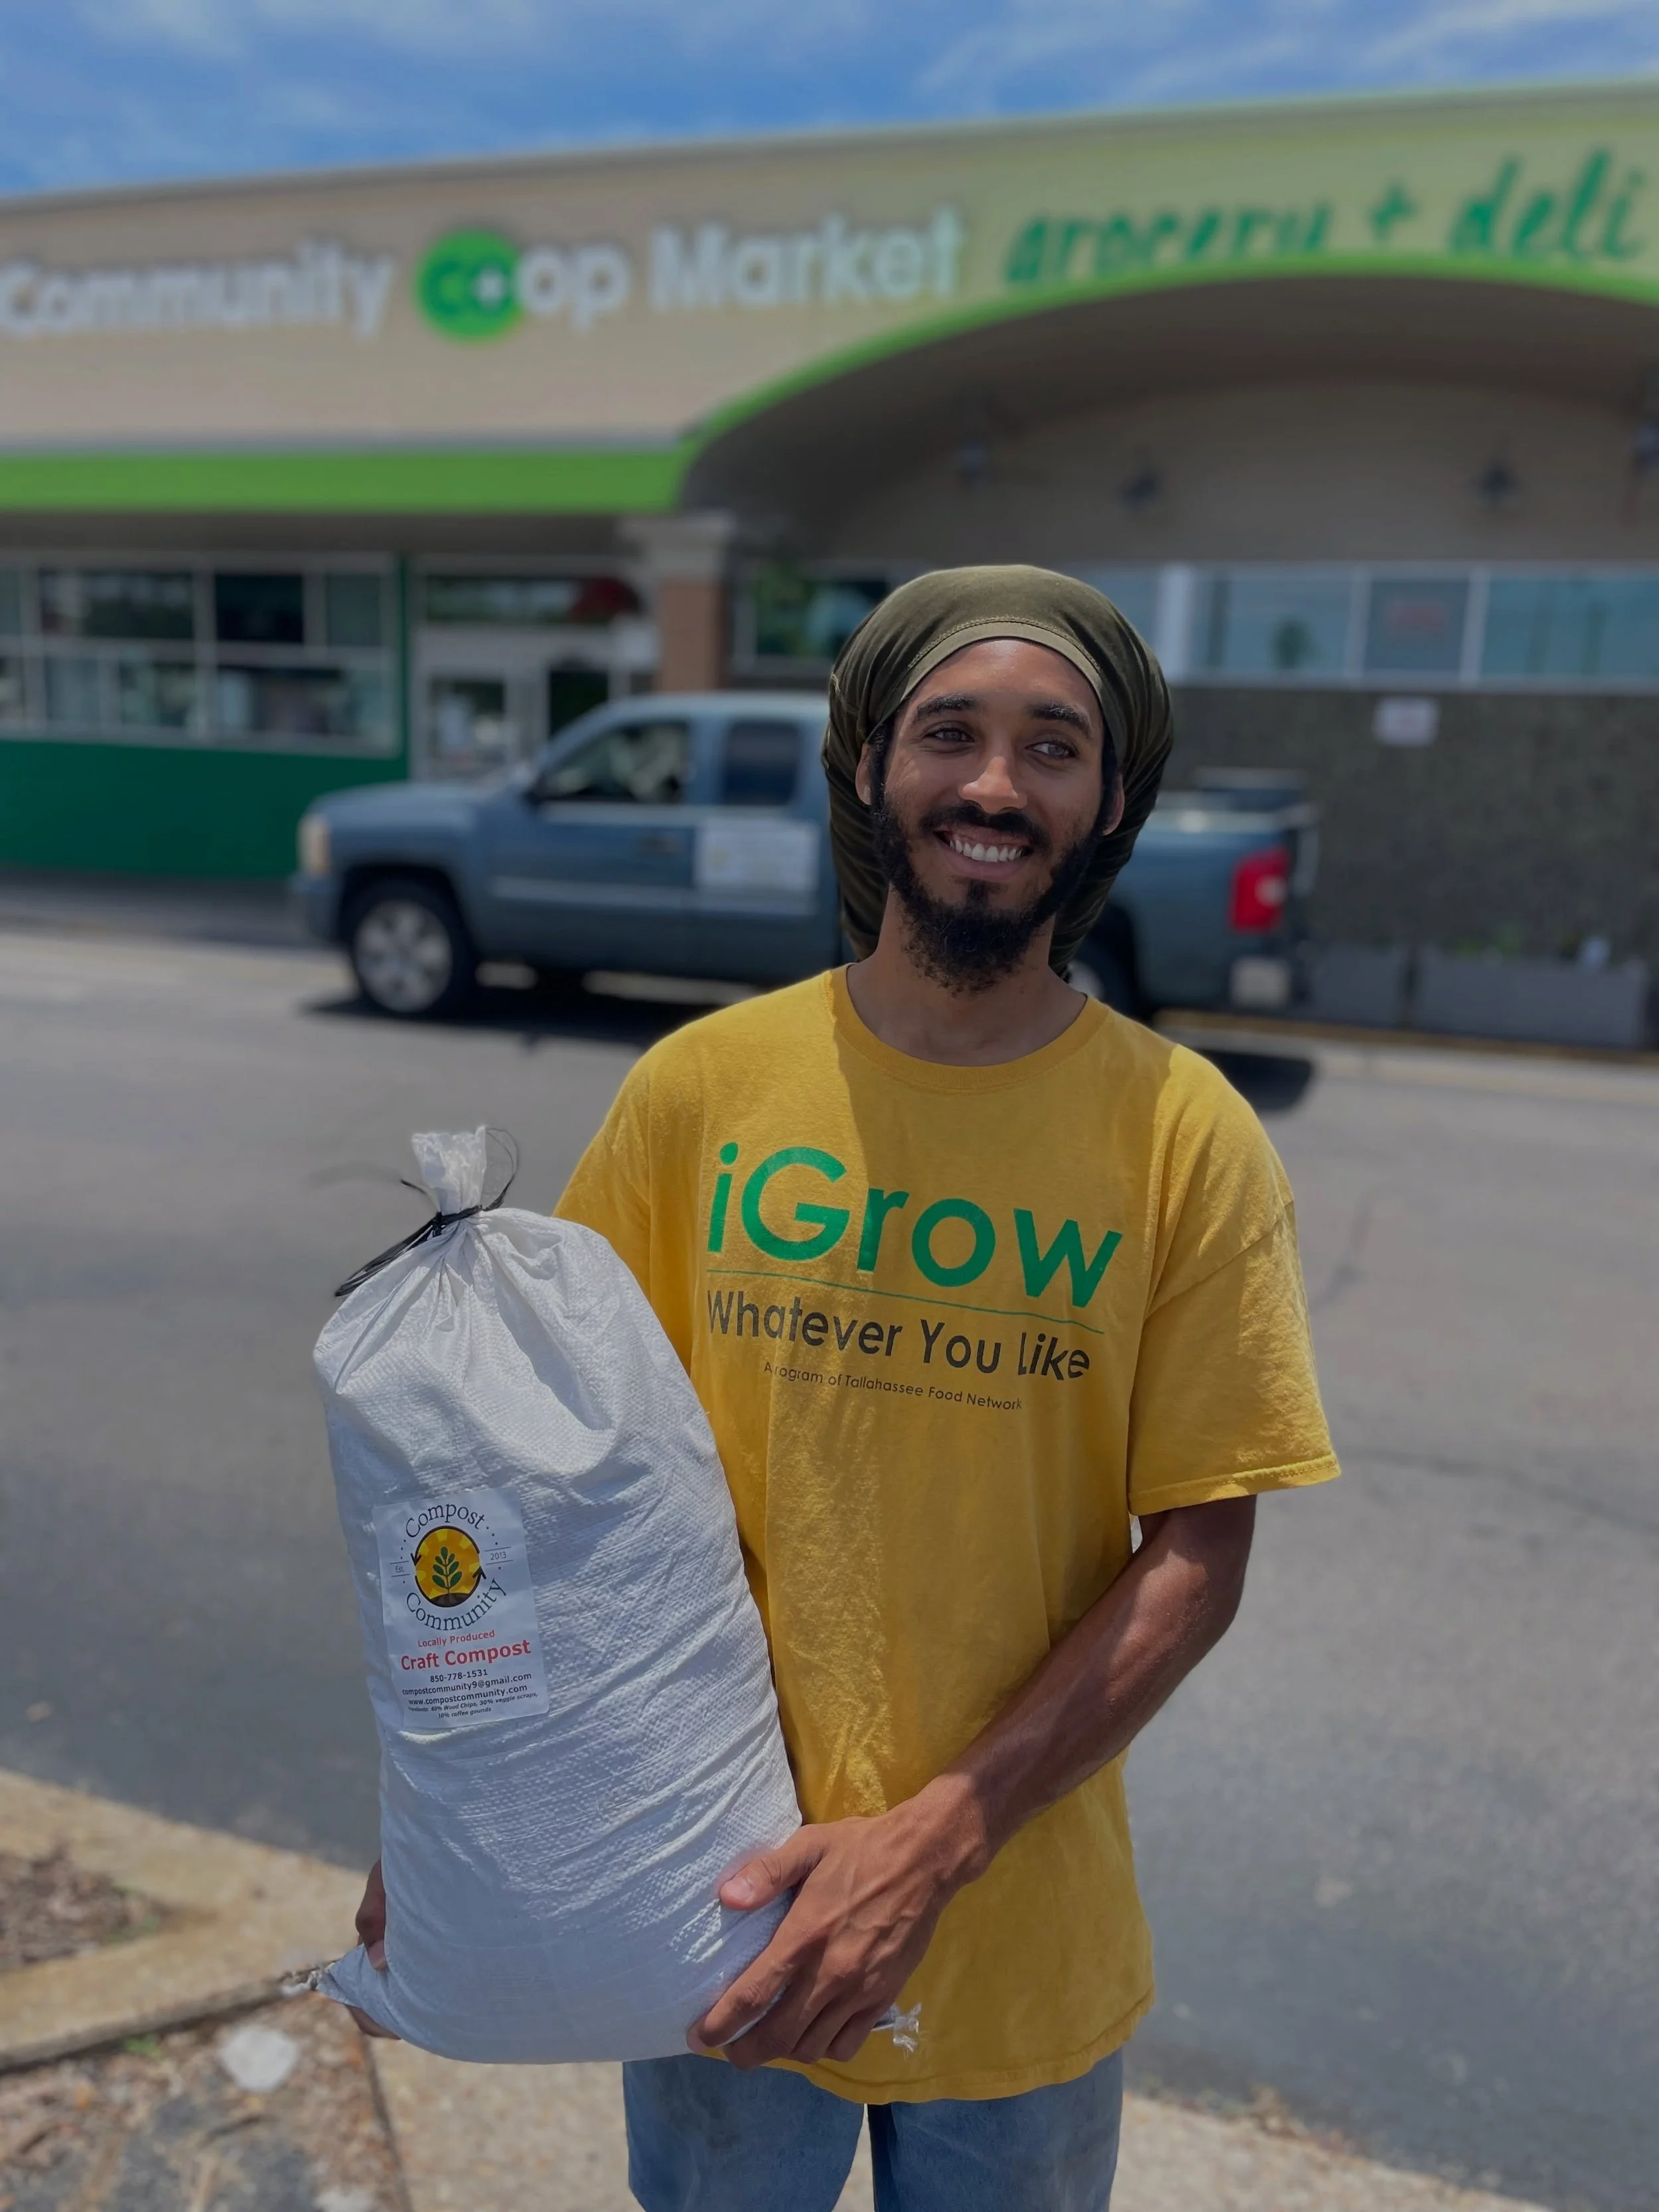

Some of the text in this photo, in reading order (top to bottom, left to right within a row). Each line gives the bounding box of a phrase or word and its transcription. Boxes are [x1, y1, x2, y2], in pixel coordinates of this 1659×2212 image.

[1449, 149, 1644, 261] deli
[0, 239, 396, 341] Community
[649, 202, 961, 312] Market
[707, 1142, 1123, 1308] iGrow
[707, 1290, 1090, 1380] Whatever You Like
[764, 1361, 1022, 1410] A rogram of Tallahassee Food Network
[405, 1503, 485, 1538] Compost
[490, 1551, 507, 1560] 2013
[406, 1578, 506, 1631] Community
[401, 1639, 531, 1670] Craft Compost
[418, 1630, 495, 1648] Locally Produced
[402, 1673, 532, 1696] compostcommunity9@gmail.com
[430, 1668, 488, 1682] 850-778-1531
[408, 1685, 528, 1705] www.compostcommunity.com
[495, 1695, 516, 1704] veggie
